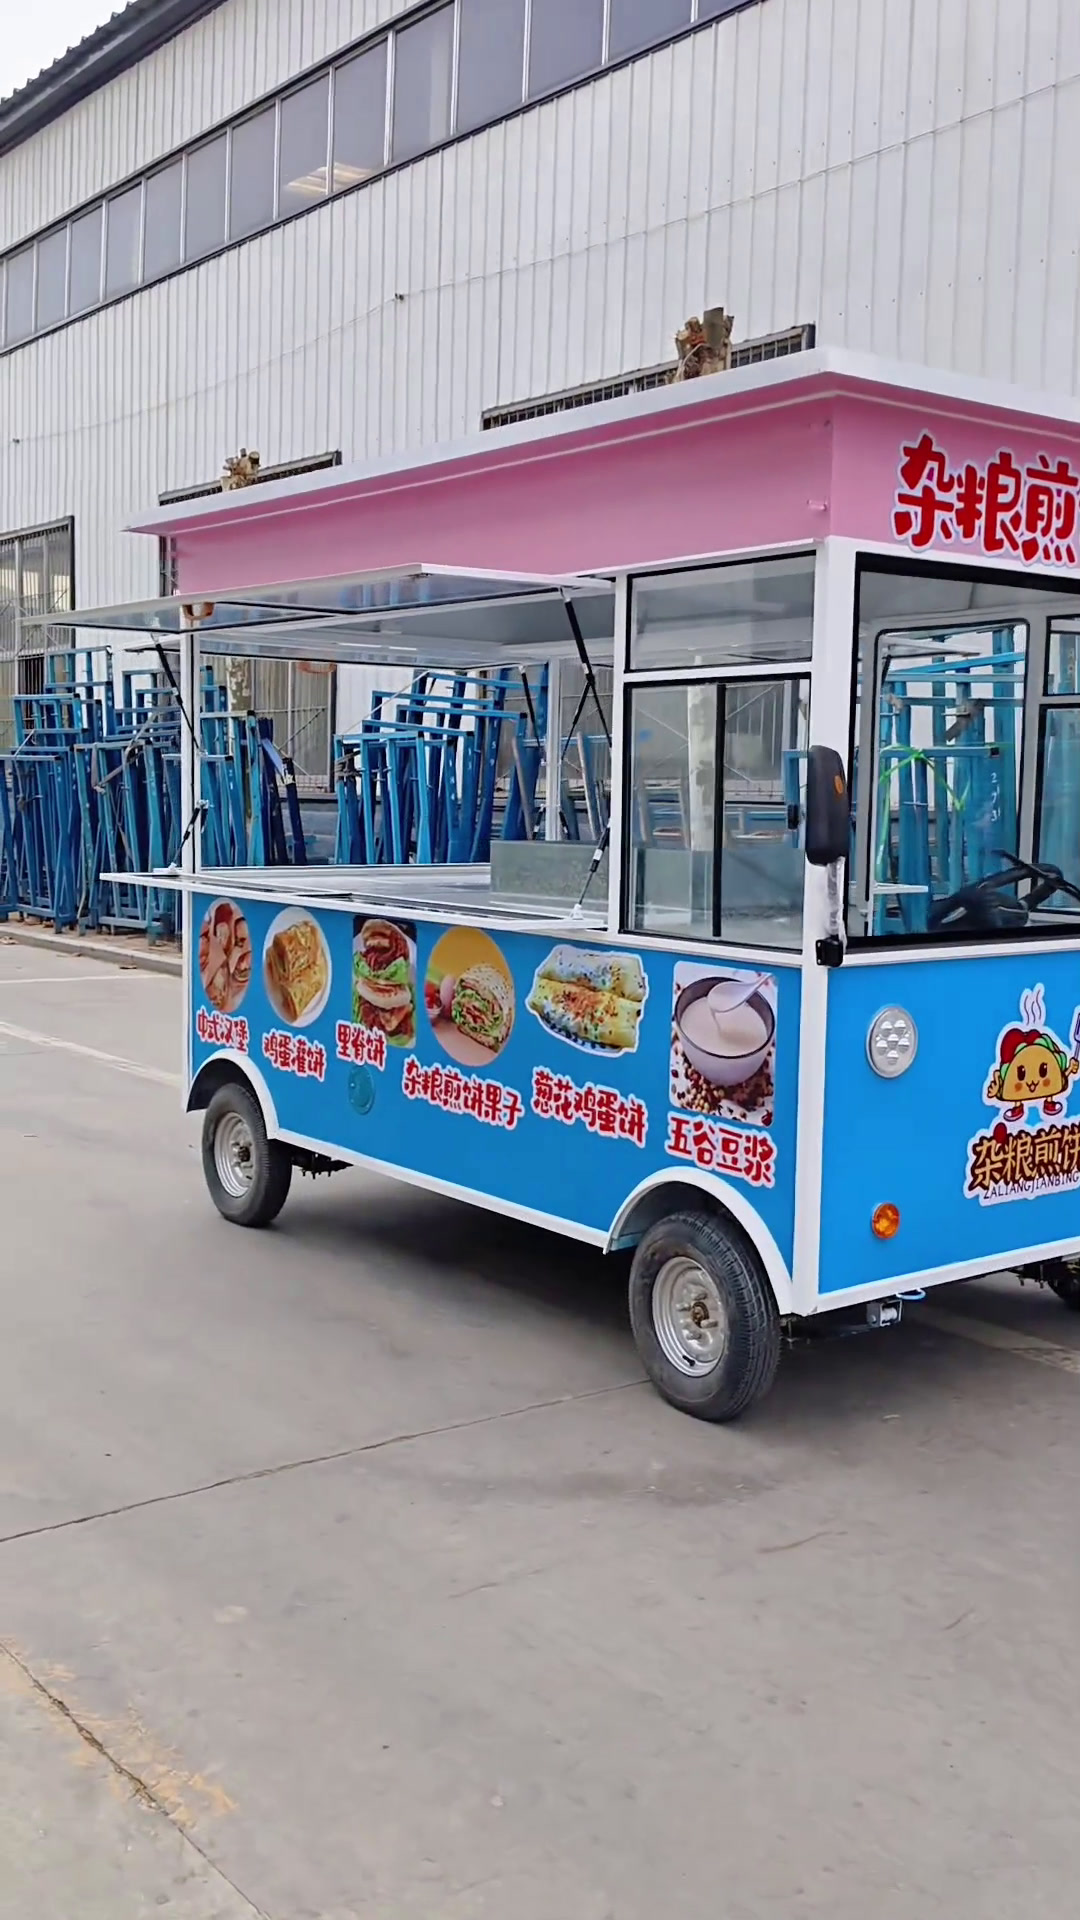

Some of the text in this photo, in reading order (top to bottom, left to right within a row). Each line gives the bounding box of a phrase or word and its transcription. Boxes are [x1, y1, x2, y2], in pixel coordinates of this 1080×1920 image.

[197, 1009, 248, 1053] 中式汉堡
[263, 1031, 326, 1079] 鸡蛋灌饼
[337, 1022, 386, 1068] 里脊饼
[403, 1058, 523, 1127] 杂粮煎饼果子
[532, 1070, 646, 1145] 葱花鸡蛋饼
[667, 1114, 775, 1184] 五谷豆浆
[983, 1171, 1080, 1199] ZALIANGJIANBING
